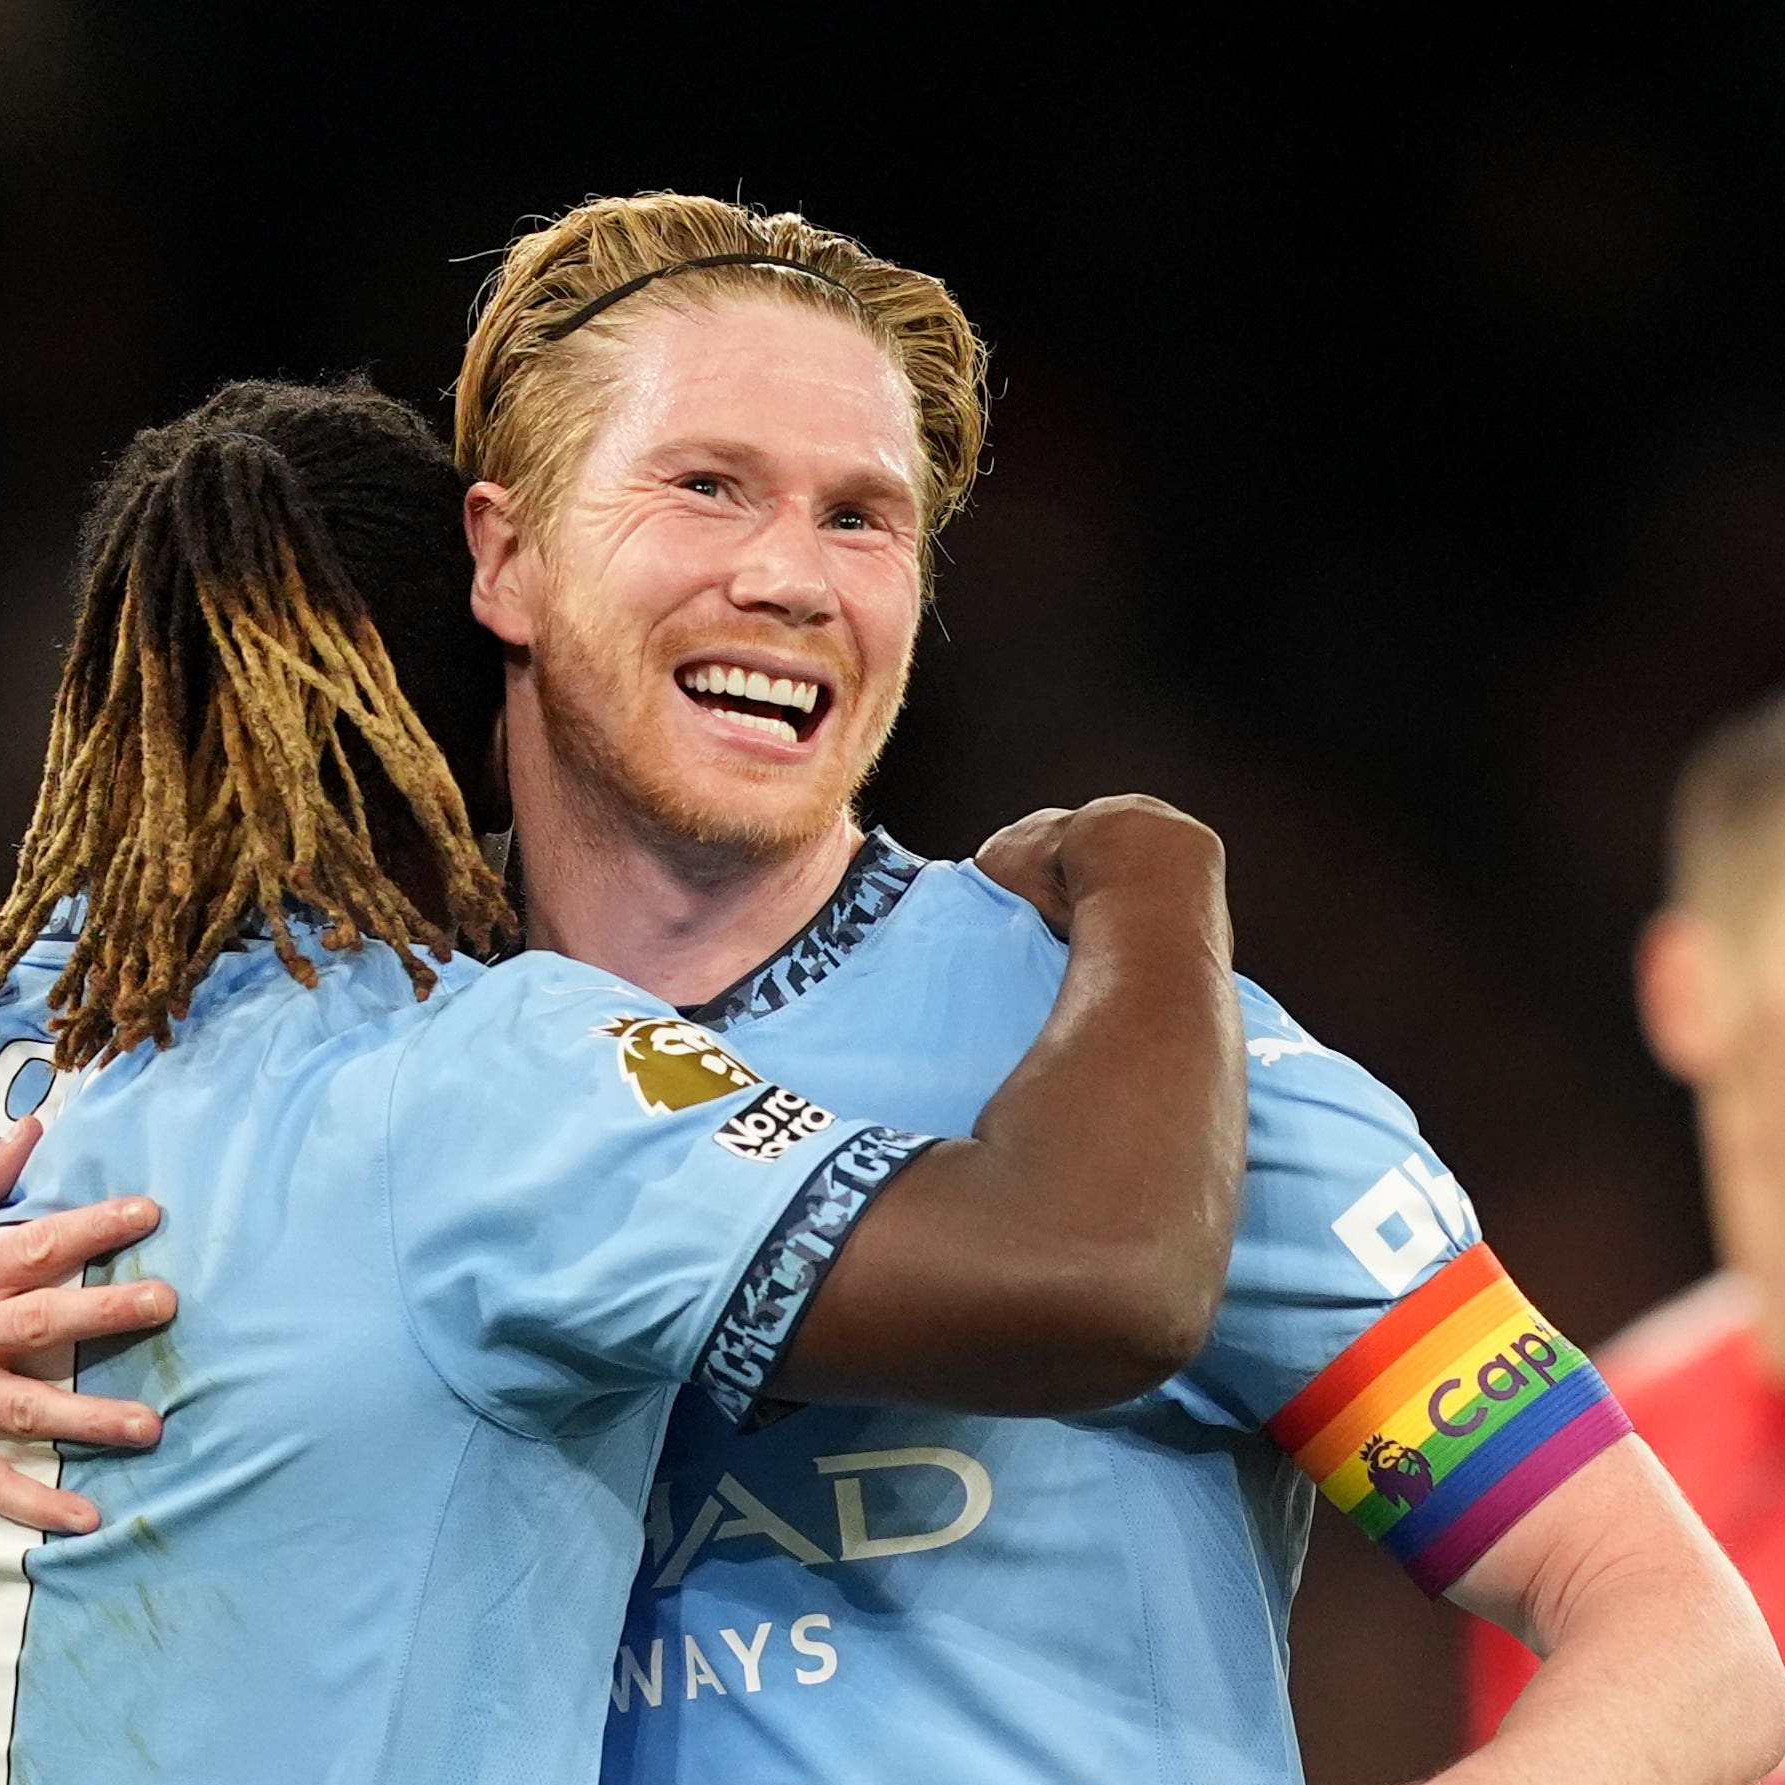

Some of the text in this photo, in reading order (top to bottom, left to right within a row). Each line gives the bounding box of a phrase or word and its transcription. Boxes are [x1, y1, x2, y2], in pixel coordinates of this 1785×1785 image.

[714, 1088, 807, 1158] No ro
[787, 1104, 837, 1138] ra
[1330, 1152, 1482, 1298] OK
[1428, 1330, 1558, 1437] Cap
[610, 1613, 838, 1713] WAYS
